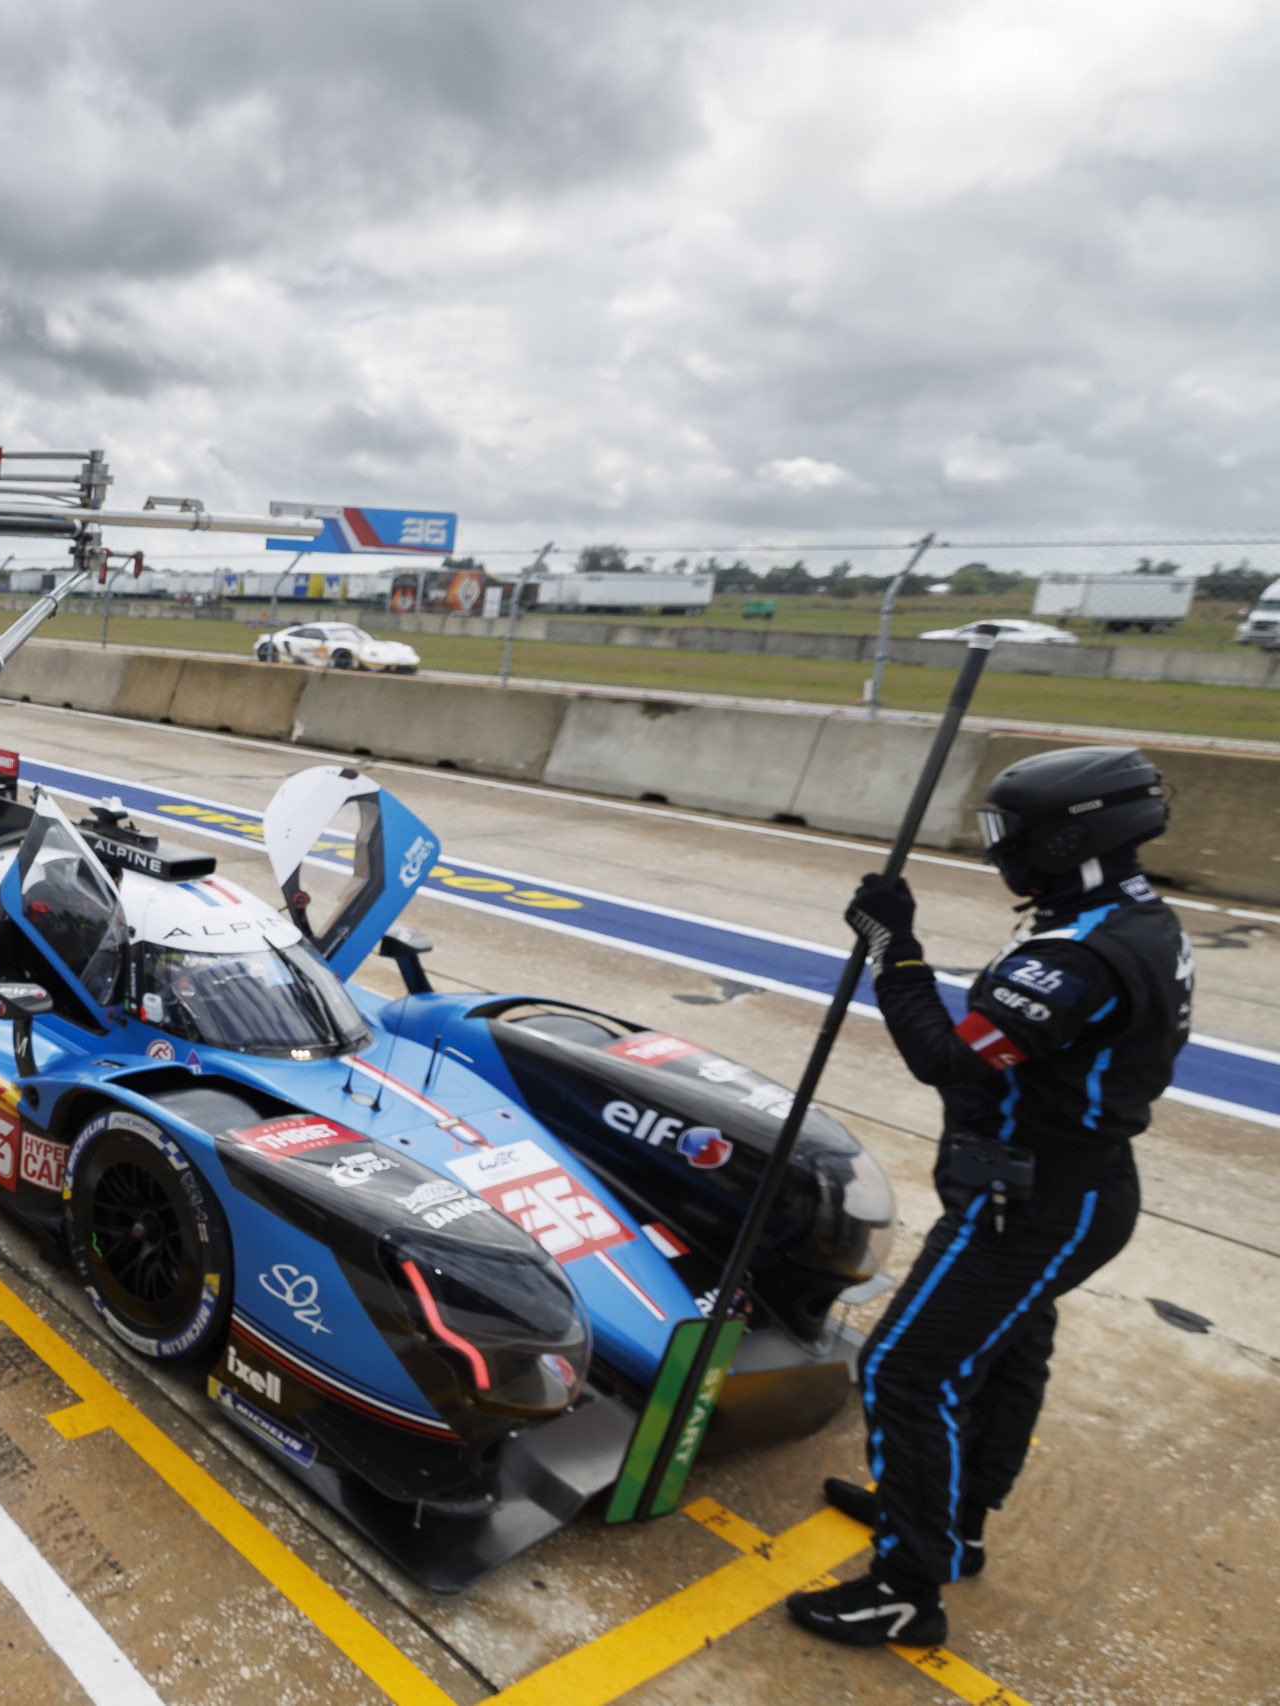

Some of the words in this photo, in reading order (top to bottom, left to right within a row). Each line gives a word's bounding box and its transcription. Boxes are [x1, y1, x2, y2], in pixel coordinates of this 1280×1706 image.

[399, 517, 449, 546] 36
[94, 839, 162, 874] ALPINE
[993, 986, 1030, 1009] elf
[68, 1115, 106, 1173] MICHELIN
[601, 1100, 685, 1147] elf
[500, 1175, 621, 1256] 36
[162, 1307, 210, 1355] MICHELIN
[227, 1345, 281, 1404] ixell
[236, 1403, 304, 1452] MICHELIN
[675, 1367, 723, 1465] START
